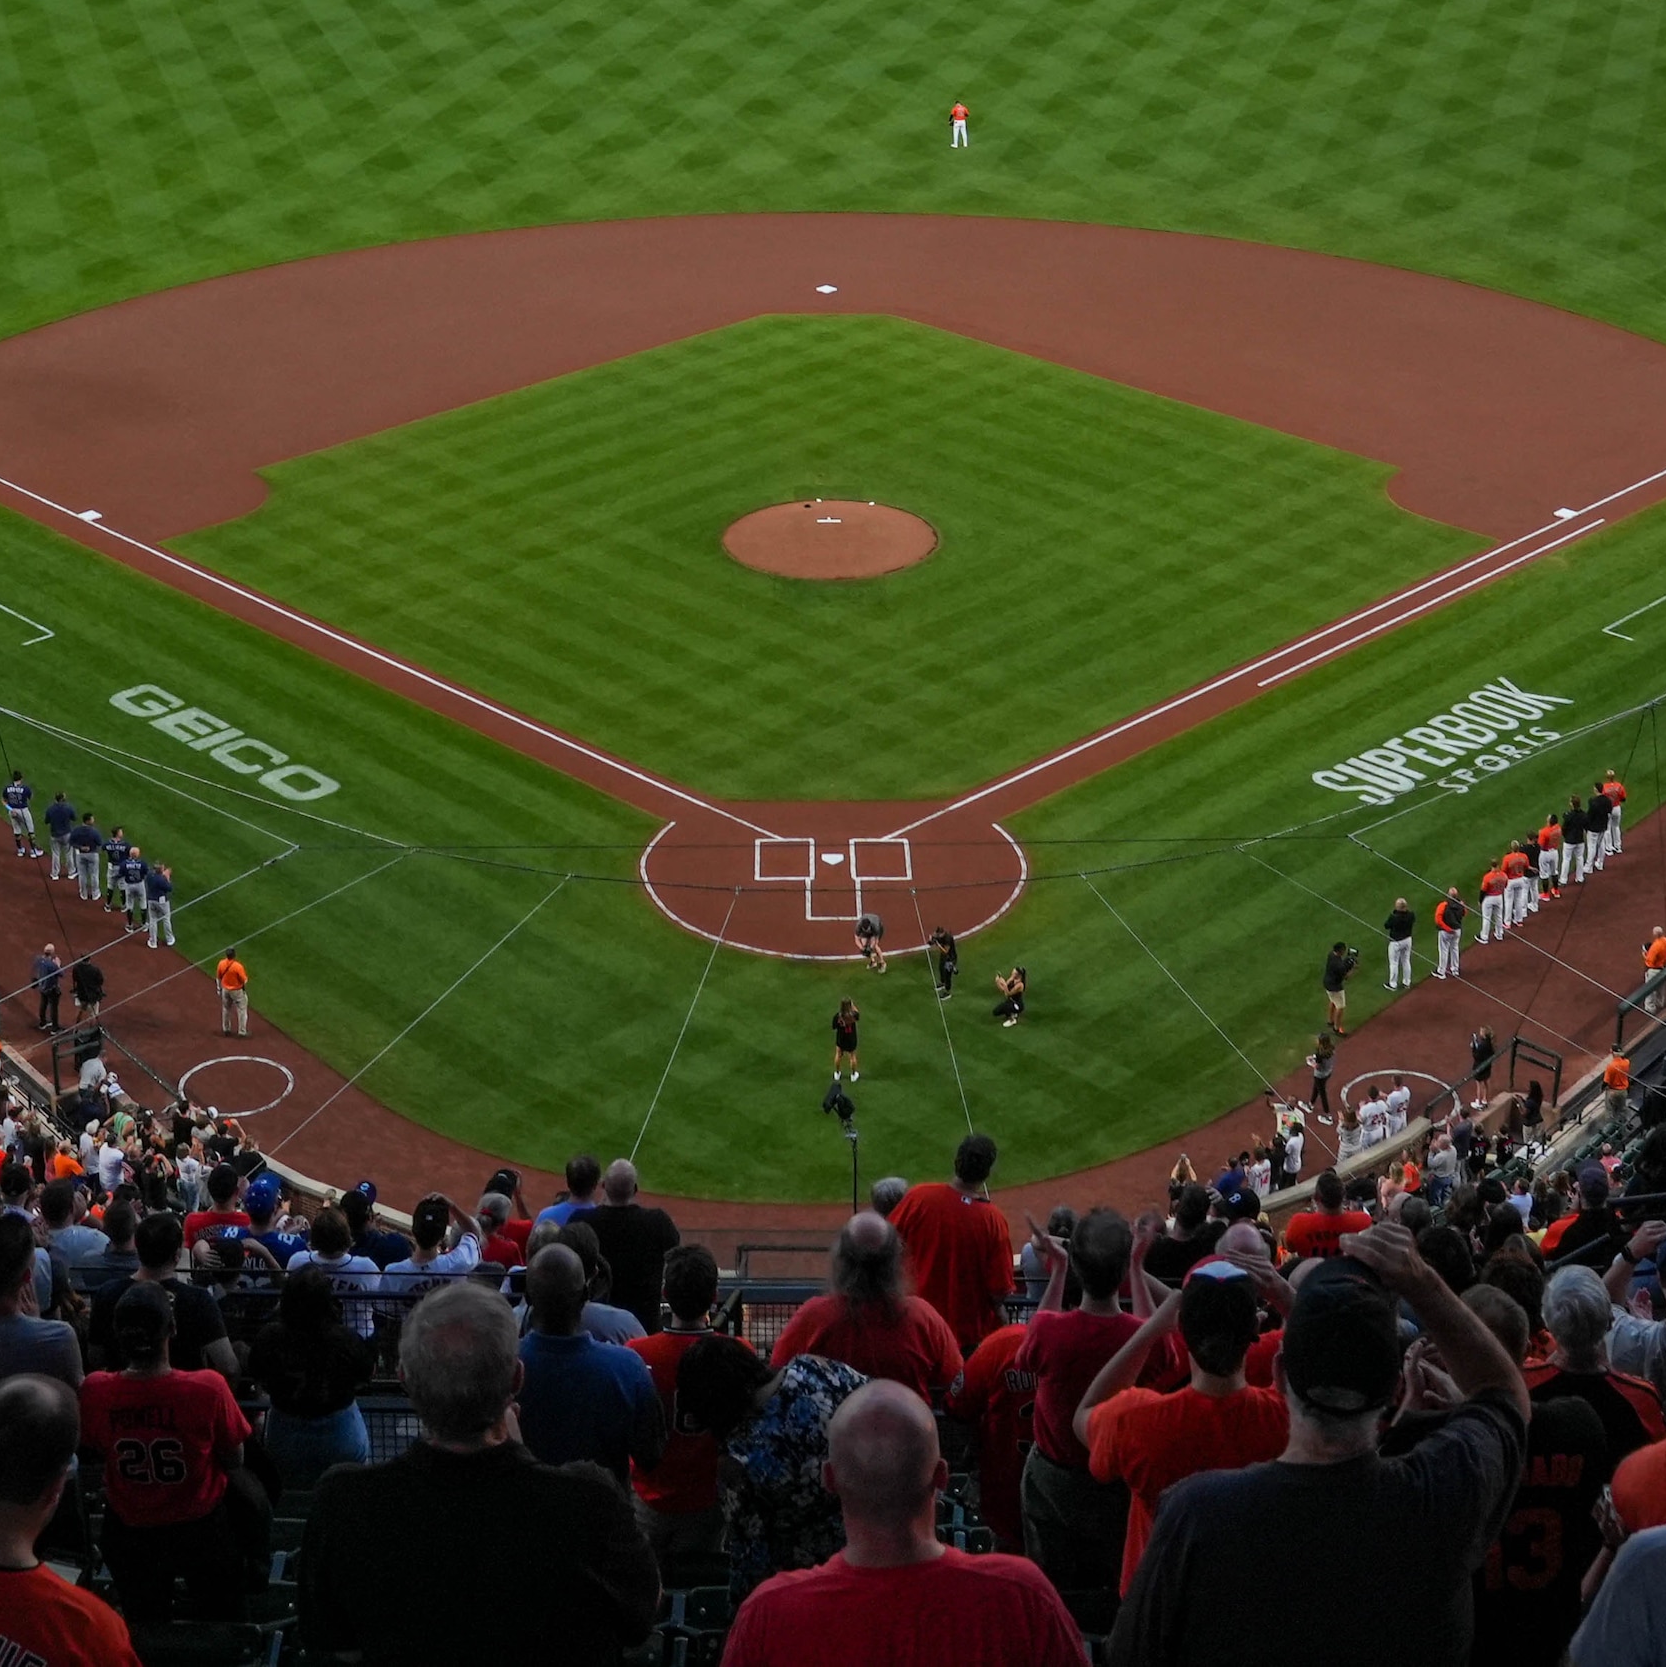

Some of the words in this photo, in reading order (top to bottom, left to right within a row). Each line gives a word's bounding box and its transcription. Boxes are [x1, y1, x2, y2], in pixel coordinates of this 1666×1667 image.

[108, 682, 342, 801] GEICO
[1312, 676, 1574, 805] SUPERBOOK
[1436, 726, 1561, 794] SPORTS
[114, 1437, 188, 1484] 26
